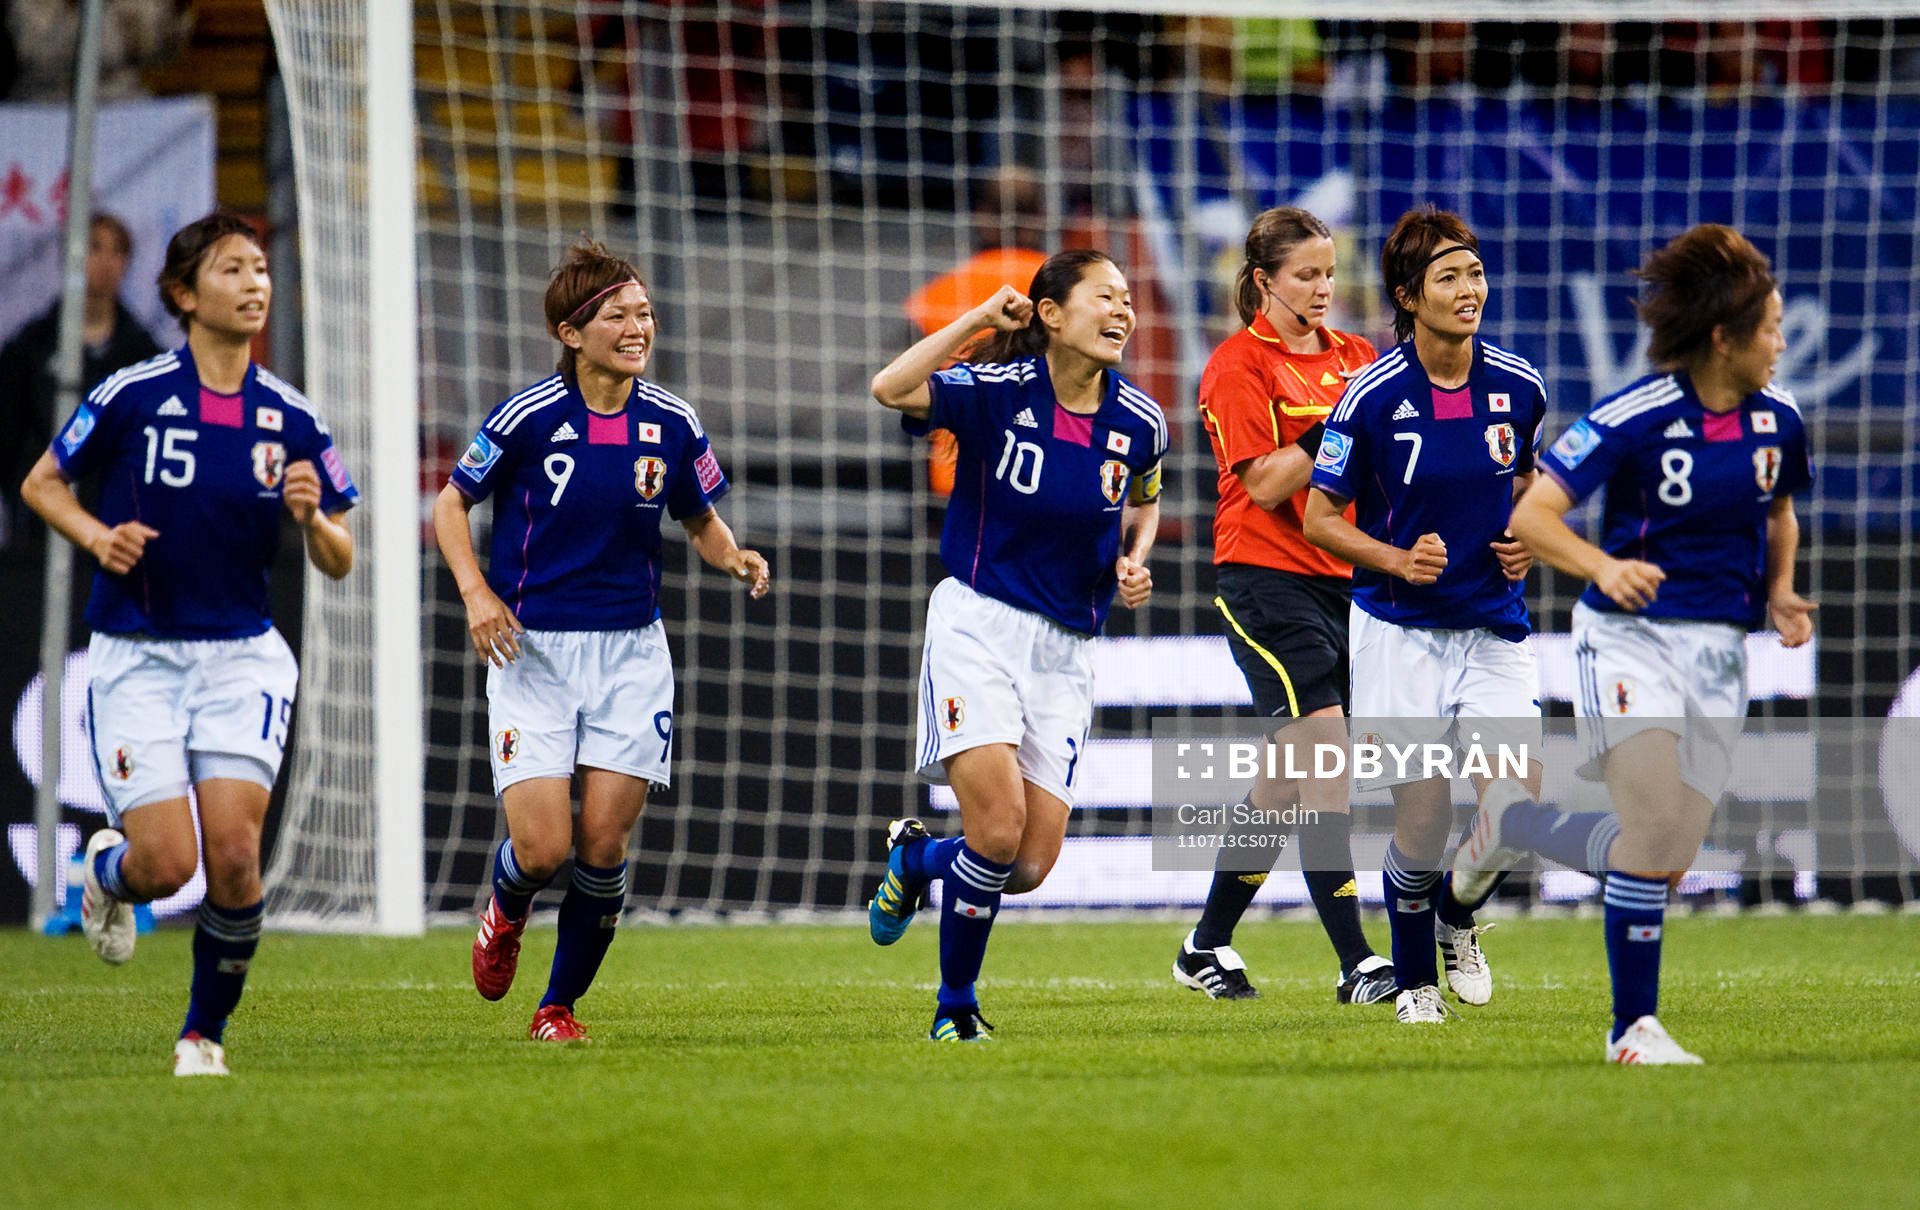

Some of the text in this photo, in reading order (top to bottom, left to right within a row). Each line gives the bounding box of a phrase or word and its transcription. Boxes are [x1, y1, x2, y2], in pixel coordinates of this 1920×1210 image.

[143, 426, 198, 488] 15
[543, 452, 575, 507] 9
[995, 429, 1044, 495] 10
[1393, 432, 1423, 485] 7
[1657, 448, 1694, 506] 8
[653, 710, 673, 764] 9
